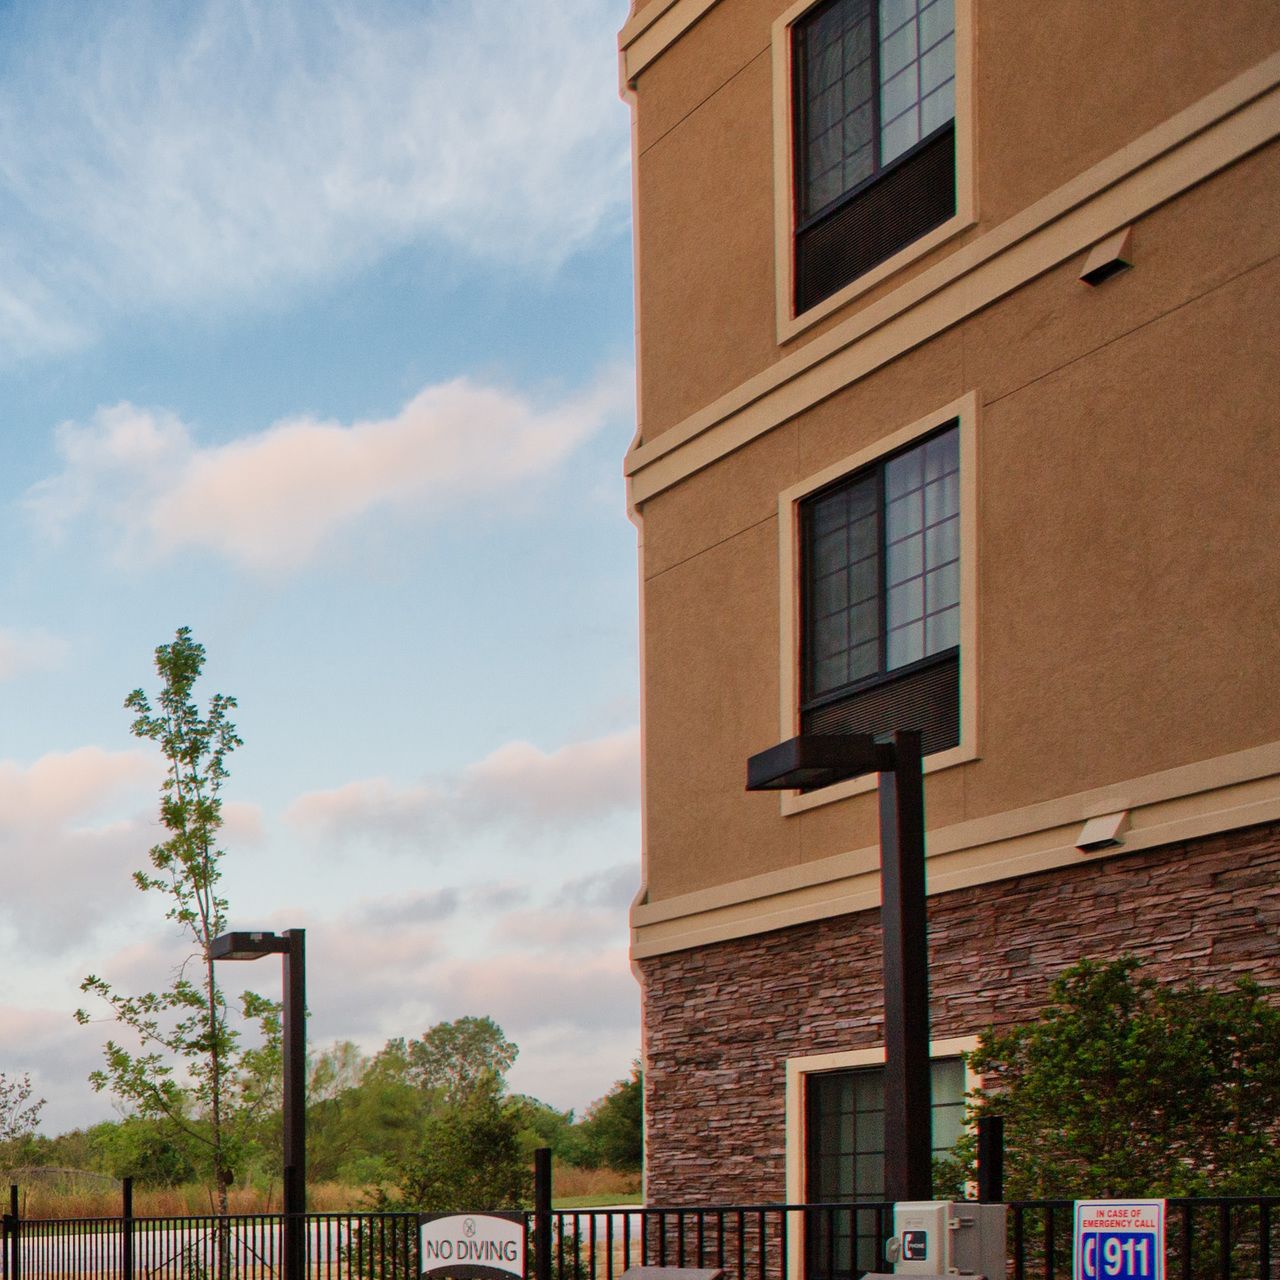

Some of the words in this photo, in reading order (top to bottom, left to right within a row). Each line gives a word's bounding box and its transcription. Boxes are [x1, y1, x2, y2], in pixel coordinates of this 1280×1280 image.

[1096, 1209, 1105, 1218] IN
[1107, 1209, 1129, 1218] CASE
[1131, 1209, 1142, 1218] OF
[1082, 1219, 1132, 1228] EMERGENCY
[1134, 1219, 1156, 1228] CALL
[427, 1239, 453, 1260] NO
[456, 1240, 518, 1261] DIVING
[1103, 1237, 1149, 1276] 911
